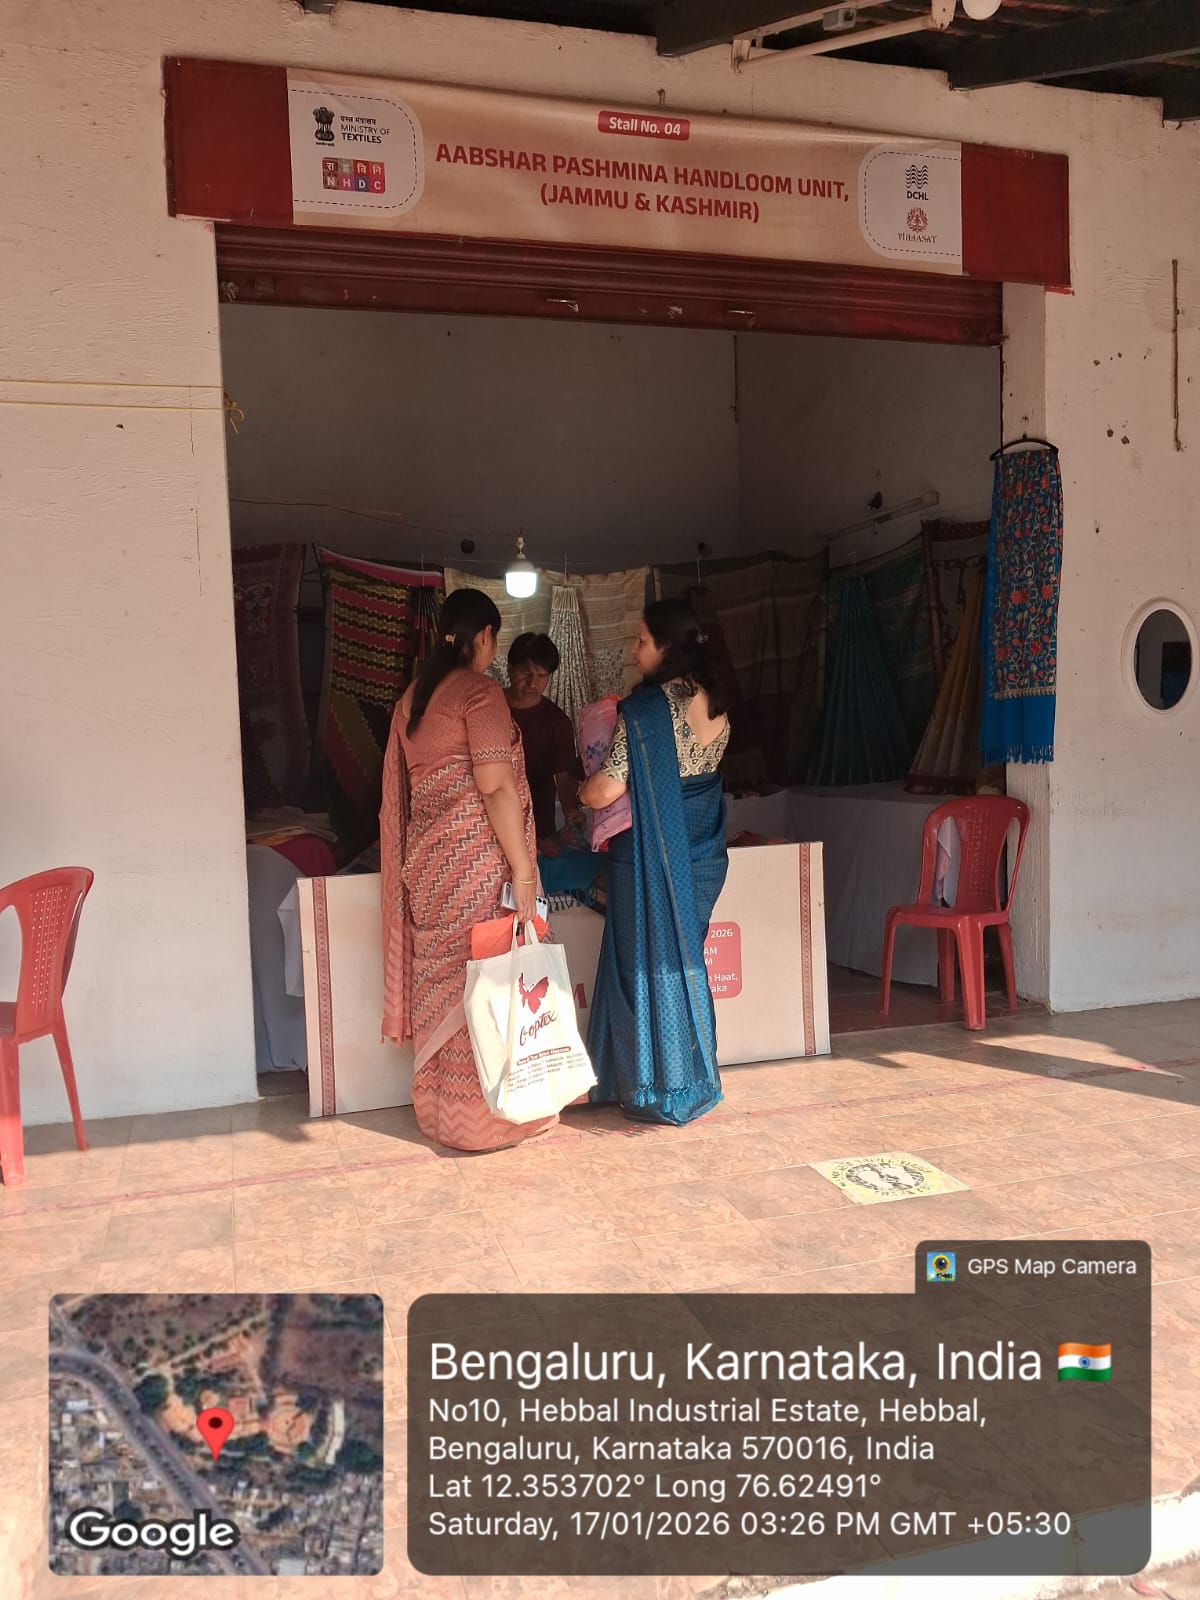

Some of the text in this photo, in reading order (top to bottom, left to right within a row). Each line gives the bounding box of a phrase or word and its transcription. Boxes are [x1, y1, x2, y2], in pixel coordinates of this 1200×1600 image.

[340, 124, 391, 136] MINISTRY OF
[609, 117, 681, 136] Stall No. 04
[341, 132, 382, 144] TEXTILES
[436, 143, 849, 202] AABSHAR PASHMINA HANDLOOM UNIT,
[906, 190, 929, 201] DCHL
[540, 183, 760, 223] (JAMMU & KASHMIR)
[710, 928, 733, 938] 2026
